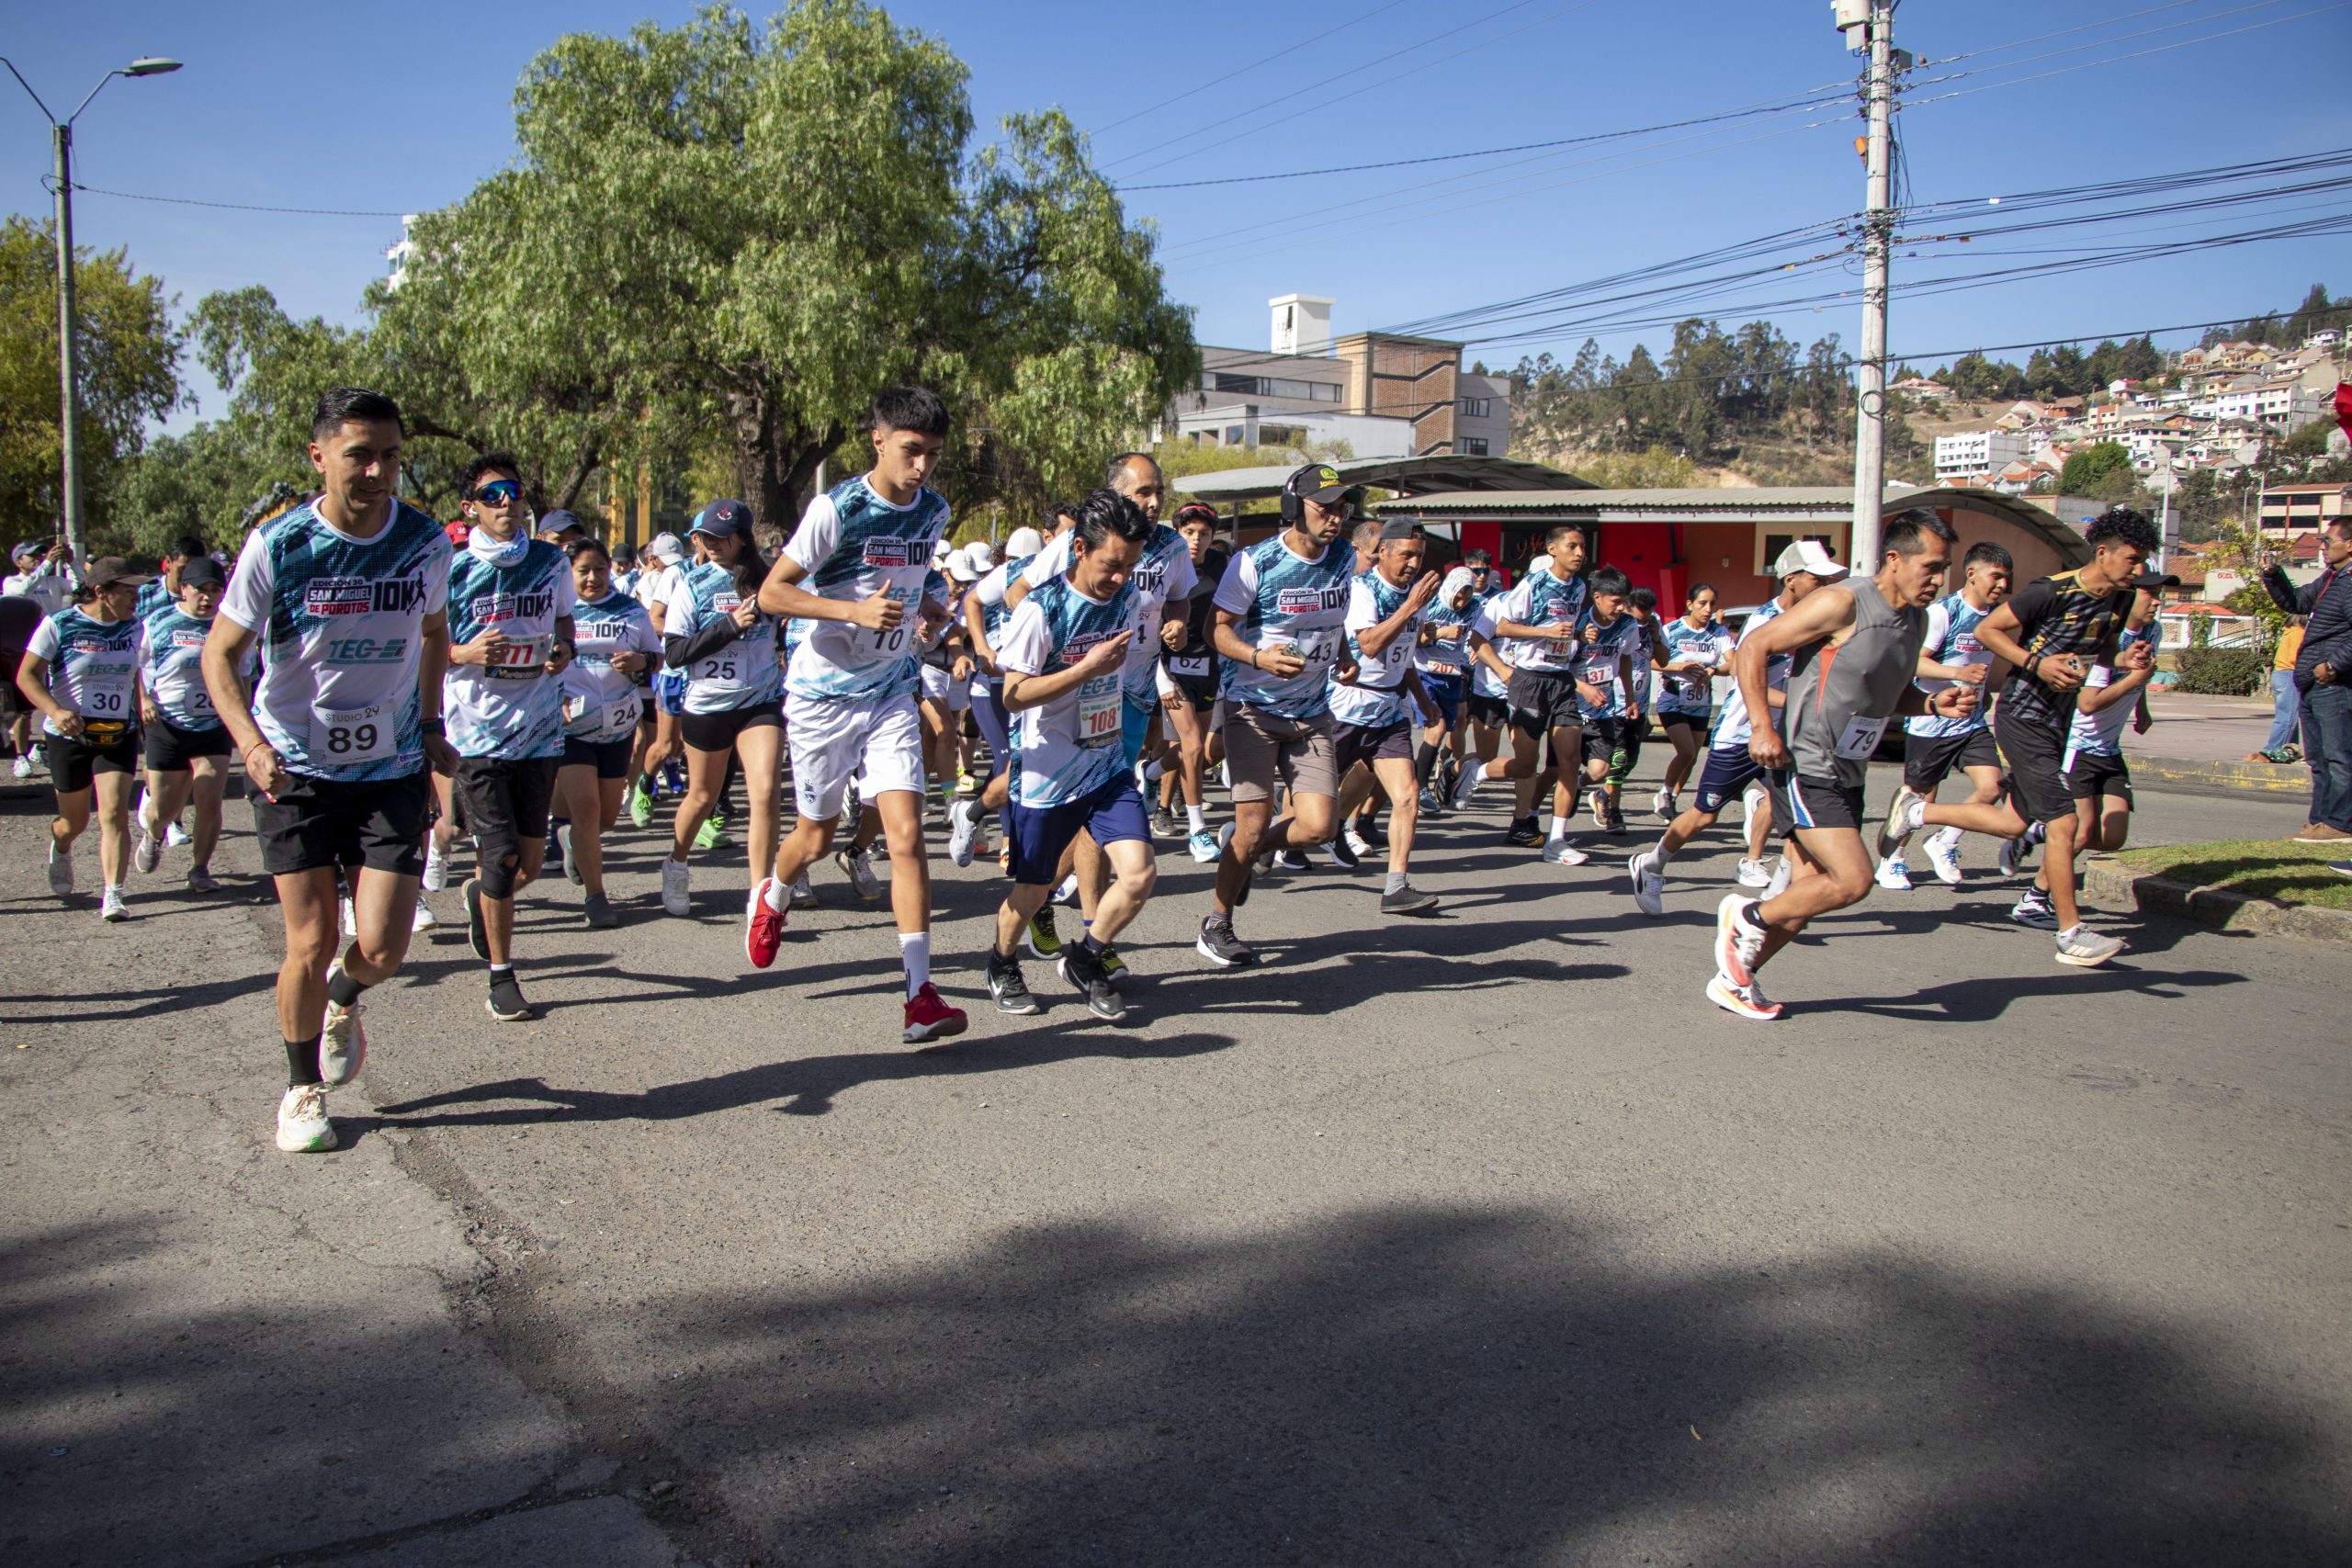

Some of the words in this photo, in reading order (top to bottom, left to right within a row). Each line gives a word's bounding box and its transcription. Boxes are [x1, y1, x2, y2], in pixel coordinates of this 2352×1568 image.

[868, 545, 884, 554] SAN
[885, 546, 906, 555] MIGUEL
[908, 542, 933, 565] 10K
[875, 557, 906, 566] POROTOS
[312, 579, 351, 587] EDICIÓN
[310, 589, 333, 601] SAN
[334, 588, 371, 601] MIGUEL
[373, 581, 417, 612] 10K
[1281, 596, 1296, 604] SAN
[1296, 594, 1319, 604] MIGUEL
[1321, 588, 1346, 610] 10K
[310, 604, 320, 613] DE
[321, 602, 370, 615] POROTOS
[477, 605, 492, 616] SAN
[516, 595, 546, 617] 10K
[1288, 604, 1319, 614] POROTOS
[595, 624, 621, 637] 10K
[1064, 645, 1080, 654] SAN
[1308, 642, 1332, 662] 43
[1392, 646, 1409, 663] 51
[706, 660, 736, 680] 25
[1180, 657, 1202, 670] 62
[1433, 663, 1454, 675] 207
[1582, 669, 1605, 683] 137
[93, 693, 121, 711] 30
[195, 693, 215, 709] 2
[325, 712, 362, 722] STUDIO
[614, 703, 637, 727] 24
[1089, 706, 1117, 734] 108
[328, 724, 378, 753] 89
[1849, 728, 1876, 751] 79
